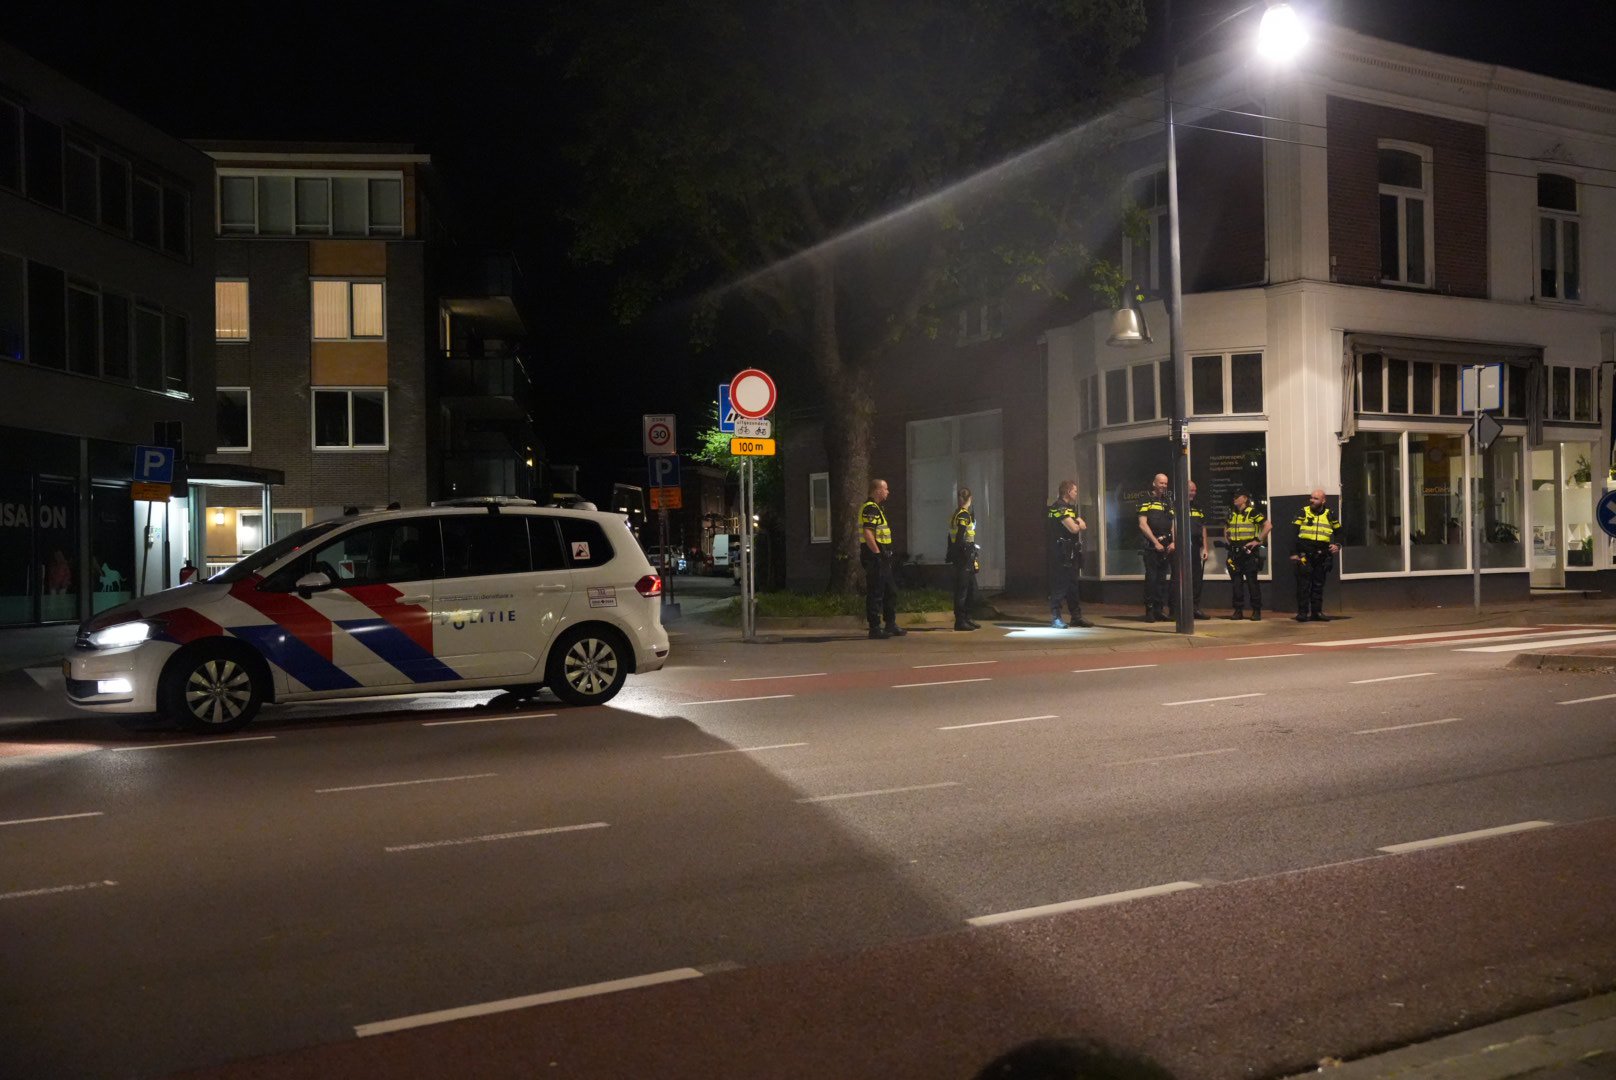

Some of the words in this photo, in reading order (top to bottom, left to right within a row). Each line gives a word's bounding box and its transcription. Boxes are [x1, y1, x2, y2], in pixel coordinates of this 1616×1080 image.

[653, 430, 667, 439] 30
[739, 442, 753, 452] 100
[144, 450, 165, 477] P
[655, 458, 673, 484] P
[0, 503, 66, 529] SAON
[441, 610, 516, 630] OLITIE
